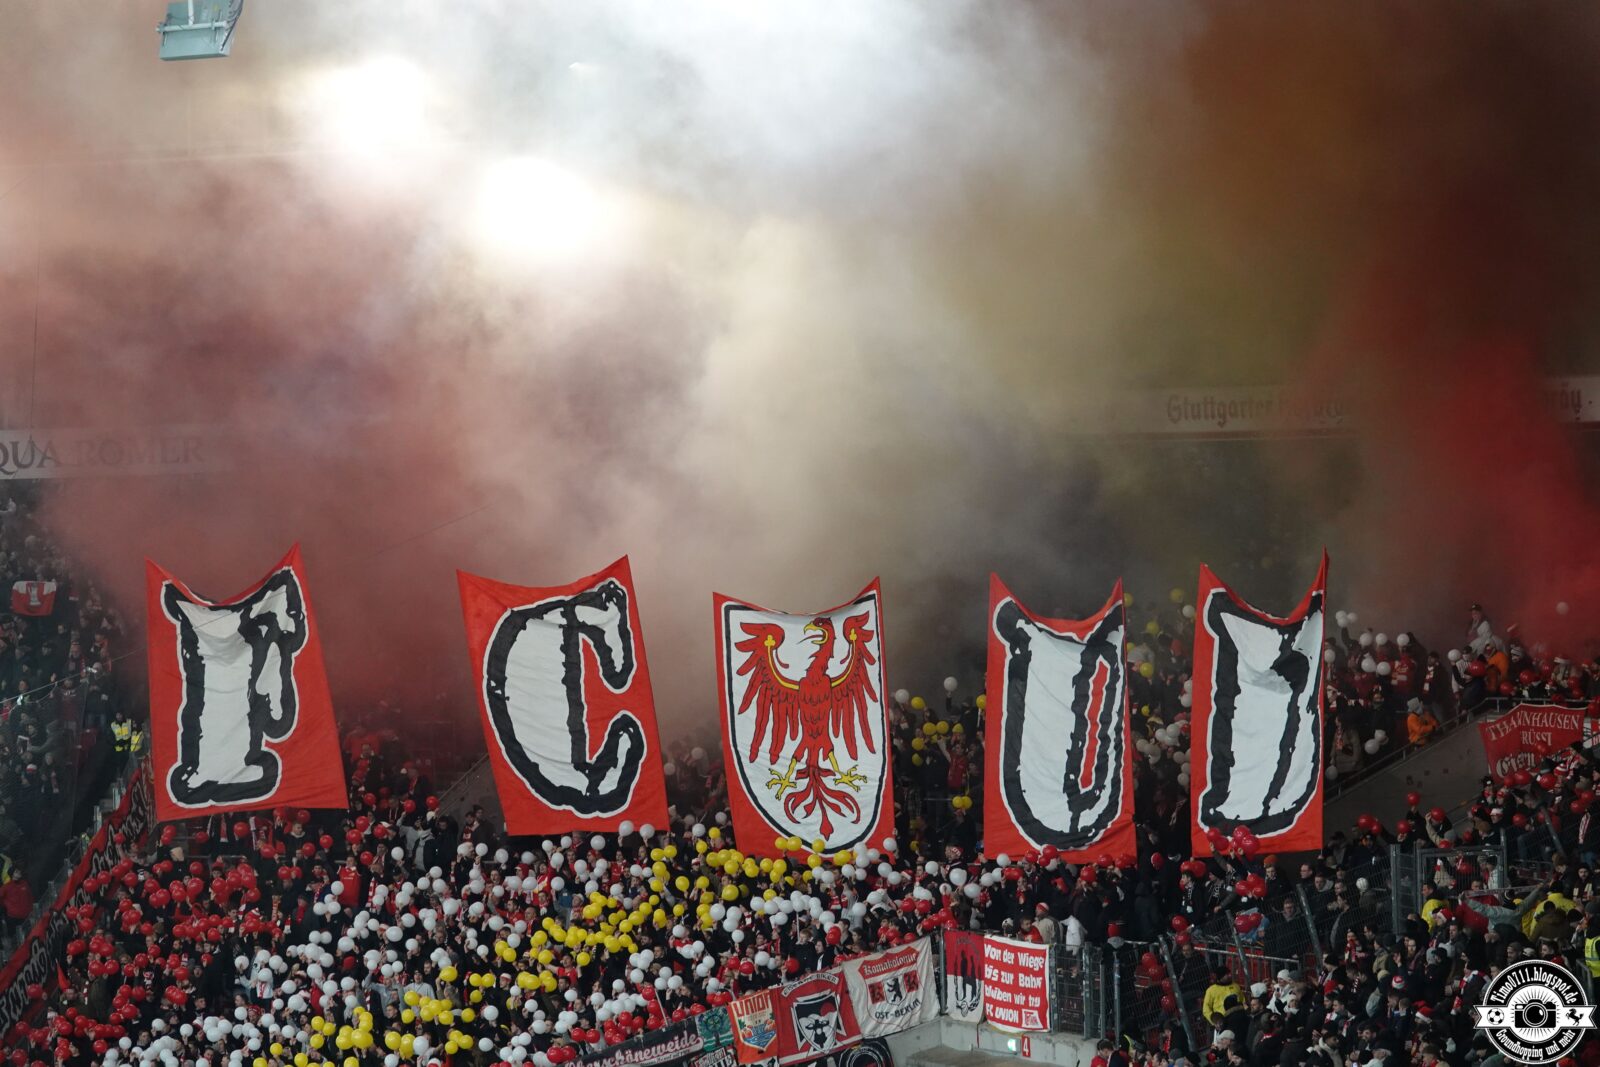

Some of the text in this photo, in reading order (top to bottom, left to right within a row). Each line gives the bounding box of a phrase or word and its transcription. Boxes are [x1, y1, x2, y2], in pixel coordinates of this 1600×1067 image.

[1167, 394, 1273, 428] Stuttgarter
[482, 576, 648, 819] C
[993, 596, 1124, 852] U
[984, 943, 1001, 961] Von
[1003, 949, 1014, 964] der
[1017, 952, 1044, 971] Wiege
[984, 963, 999, 981] bis
[1000, 970, 1014, 985] zur
[995, 1007, 1019, 1024] UNION
[1023, 1038, 1029, 1056] 4
